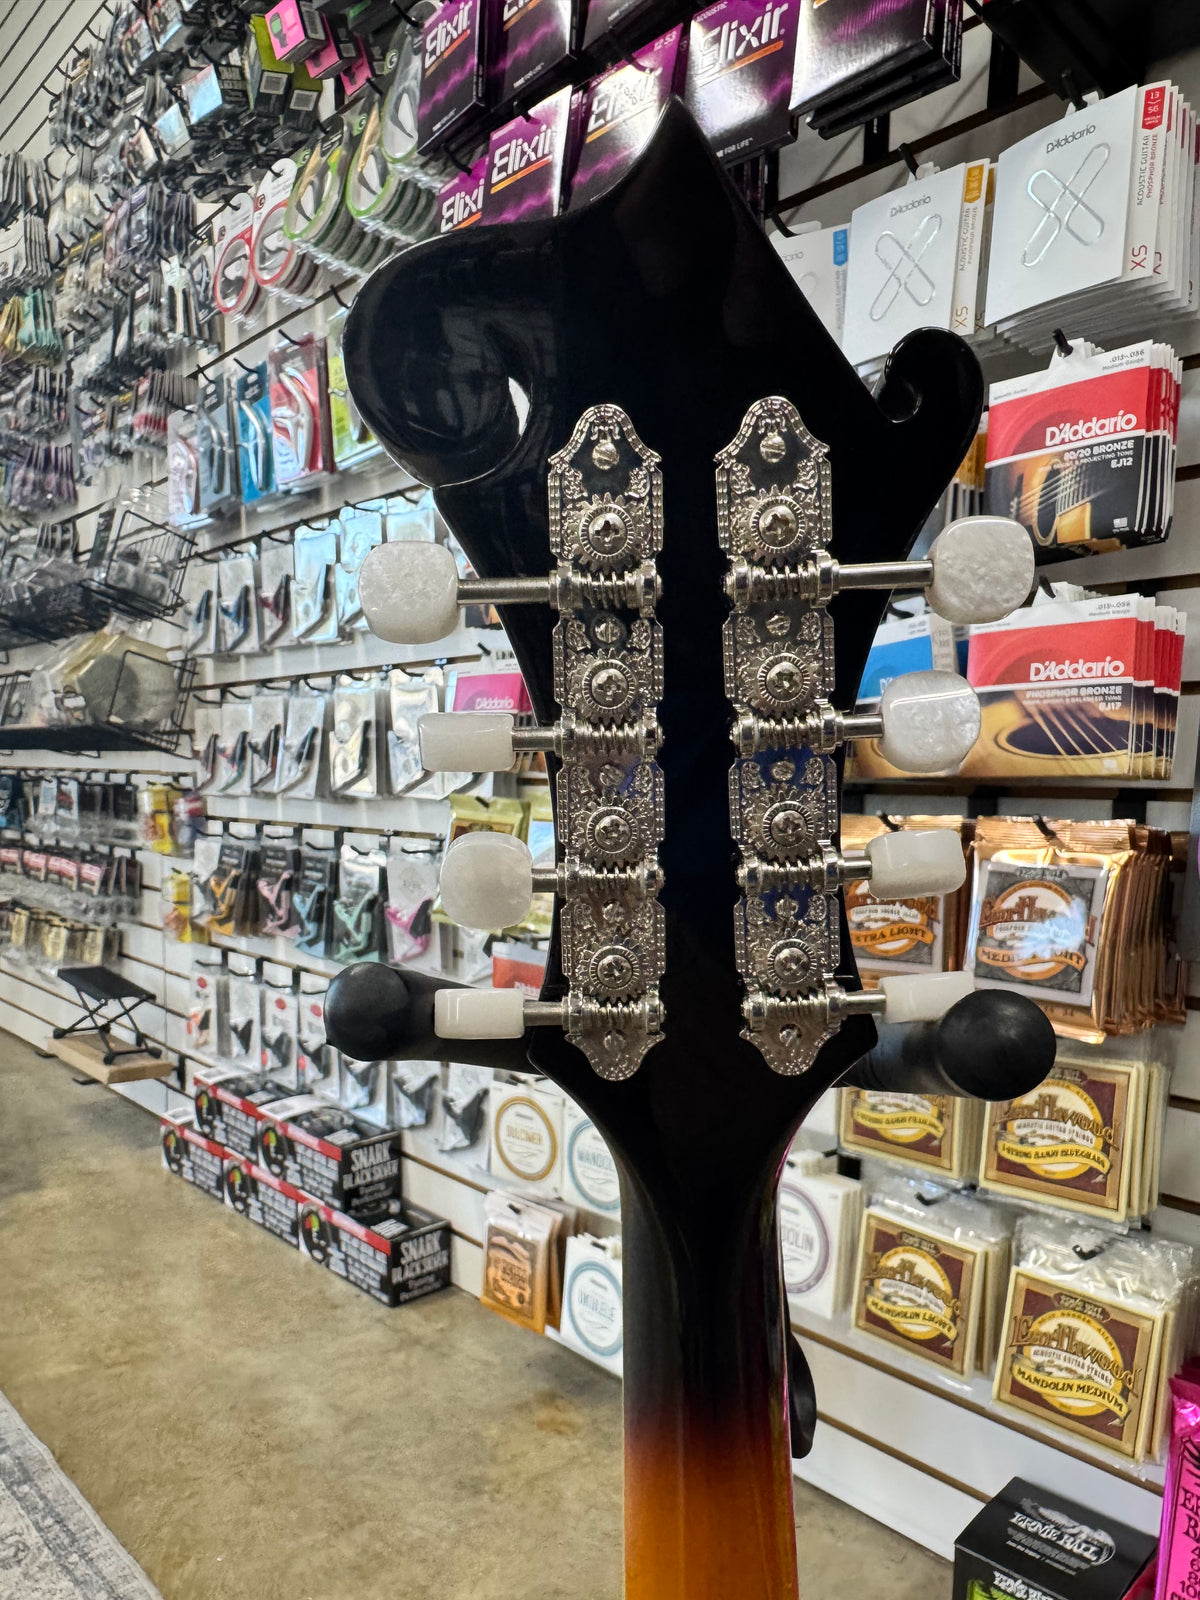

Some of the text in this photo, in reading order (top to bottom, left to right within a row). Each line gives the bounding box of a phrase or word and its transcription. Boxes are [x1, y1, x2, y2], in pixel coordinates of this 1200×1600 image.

[425, 1, 472, 68] Elixir
[694, 2, 789, 76] Elixir
[491, 124, 557, 184] Elixir
[1046, 123, 1096, 154] D'Addario
[441, 178, 484, 233] Elixi
[1129, 244, 1148, 272] XS
[1045, 410, 1137, 447] D'Addario
[1093, 440, 1135, 455] BRONZE
[1110, 457, 1133, 469] EJ12
[1029, 656, 1125, 682] D'Addario
[1026, 685, 1123, 699] PHOSPHOR BRONZE
[351, 1140, 392, 1172] SNARK
[400, 1230, 441, 1264] SNARK
[781, 1226, 814, 1253] OLIN
[1009, 1314, 1143, 1399] Earthwood
[1016, 1366, 1124, 1413] MANDOLIN MEDIUM
